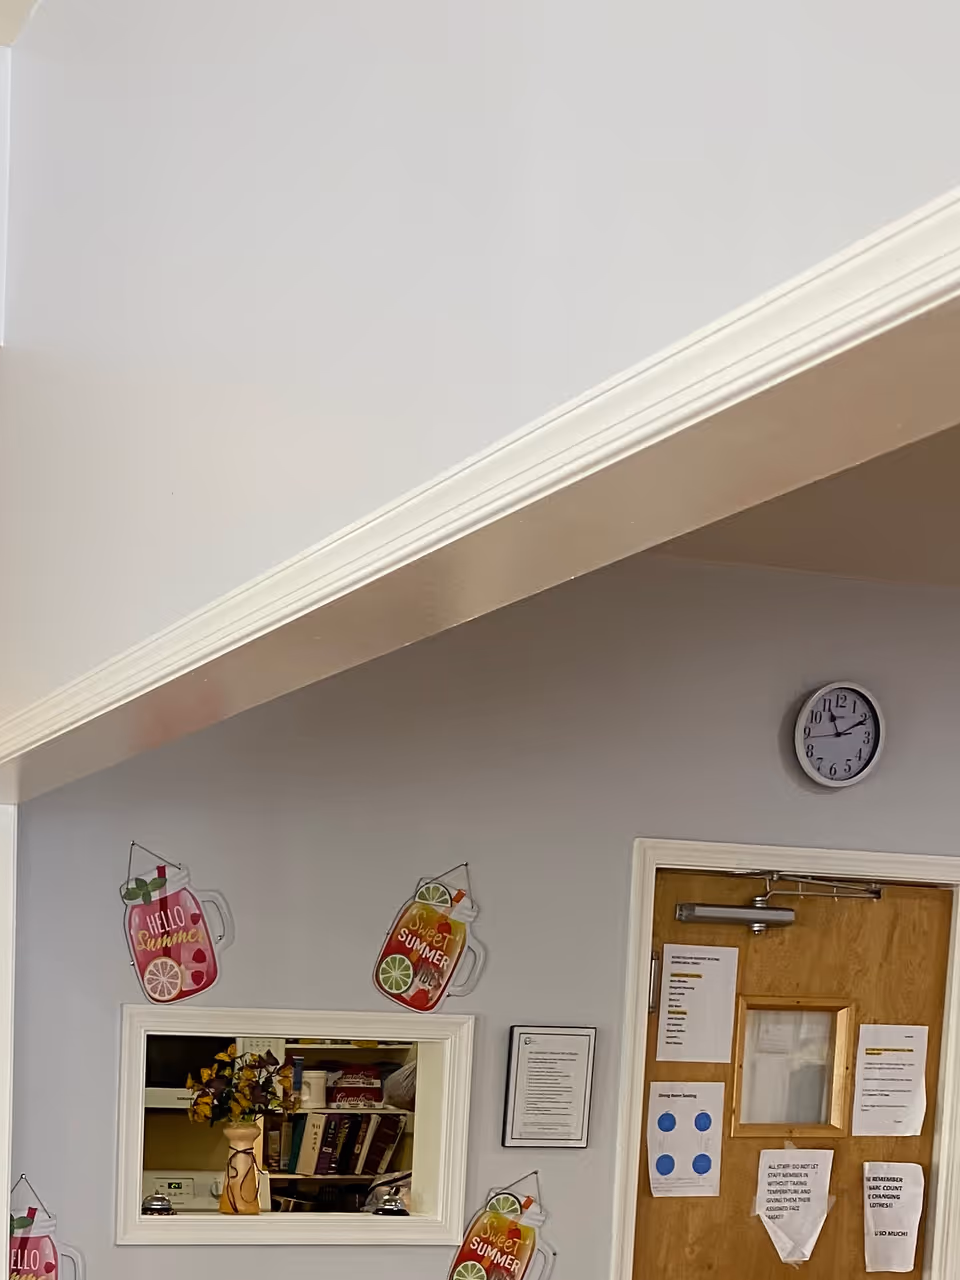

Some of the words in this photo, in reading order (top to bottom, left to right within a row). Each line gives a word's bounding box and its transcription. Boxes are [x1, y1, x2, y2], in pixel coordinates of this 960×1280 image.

[823, 698, 831, 712] 11
[835, 694, 847, 708] 12
[852, 700, 857, 714] 1
[810, 710, 822, 724] 10
[860, 712, 868, 726] 2
[804, 726, 811, 740] 9
[863, 731, 870, 744] 3
[806, 744, 814, 758] 8
[855, 748, 862, 761] 4
[816, 757, 824, 772] 7
[829, 762, 837, 776] 6
[844, 759, 852, 773] 5
[145, 905, 185, 935] HELLO
[136, 928, 203, 952] Summer
[398, 927, 450, 970] SUMMER
[10, 1249, 40, 1271] ELLO
[470, 1236, 521, 1273] SUMMER
